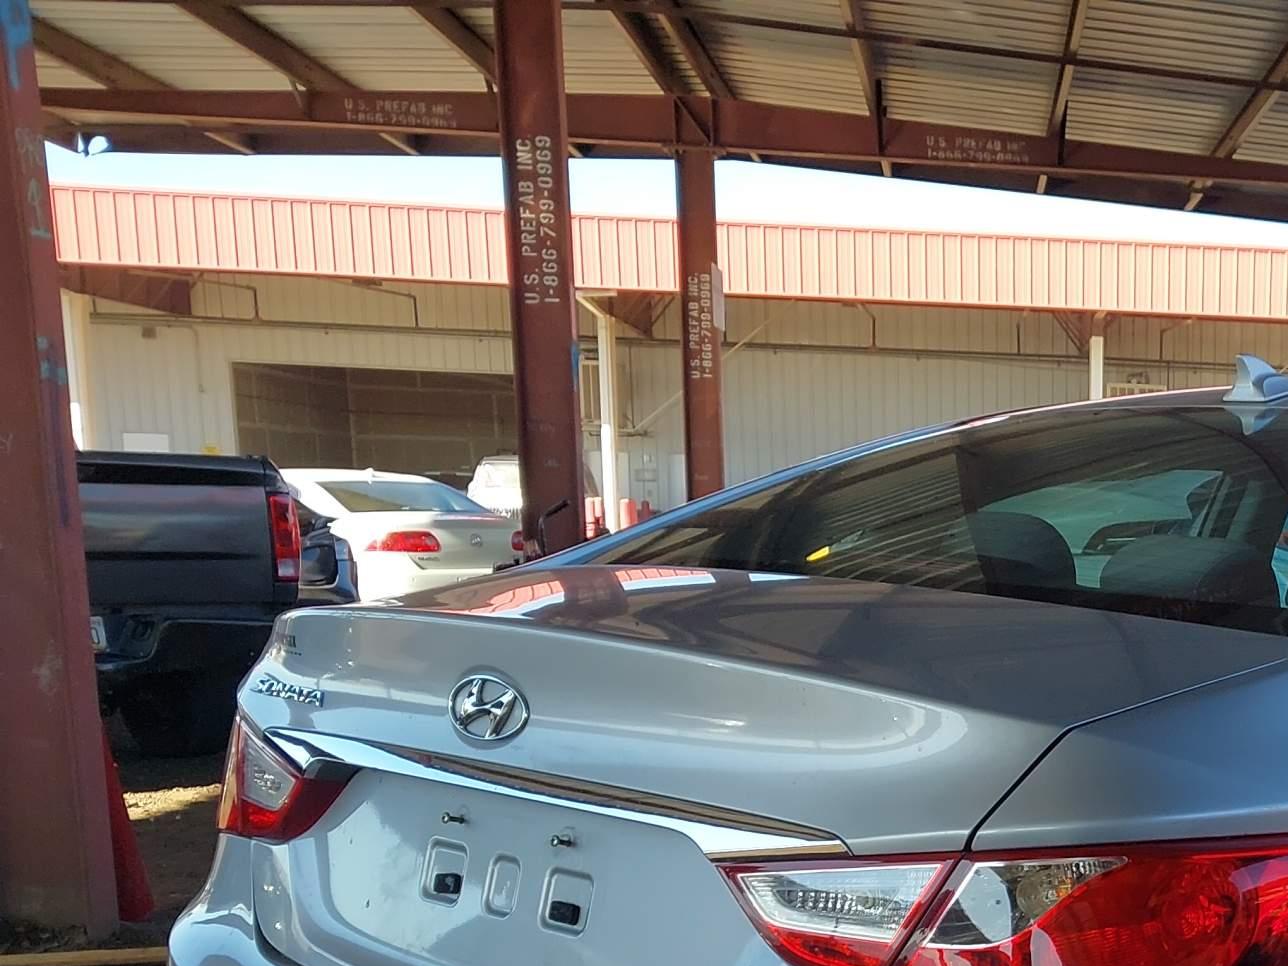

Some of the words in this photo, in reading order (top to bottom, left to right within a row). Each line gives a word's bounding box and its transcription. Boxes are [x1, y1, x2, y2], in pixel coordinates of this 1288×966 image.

[518, 180, 537, 256] PREFAB
[535, 135, 560, 303] 1-866-799-0969
[524, 268, 541, 304] U.S.
[688, 301, 700, 349] PREFAB
[700, 273, 713, 378] 1-866-799-0969
[690, 355, 701, 379] U.S.
[252, 678, 325, 707] SONATA
